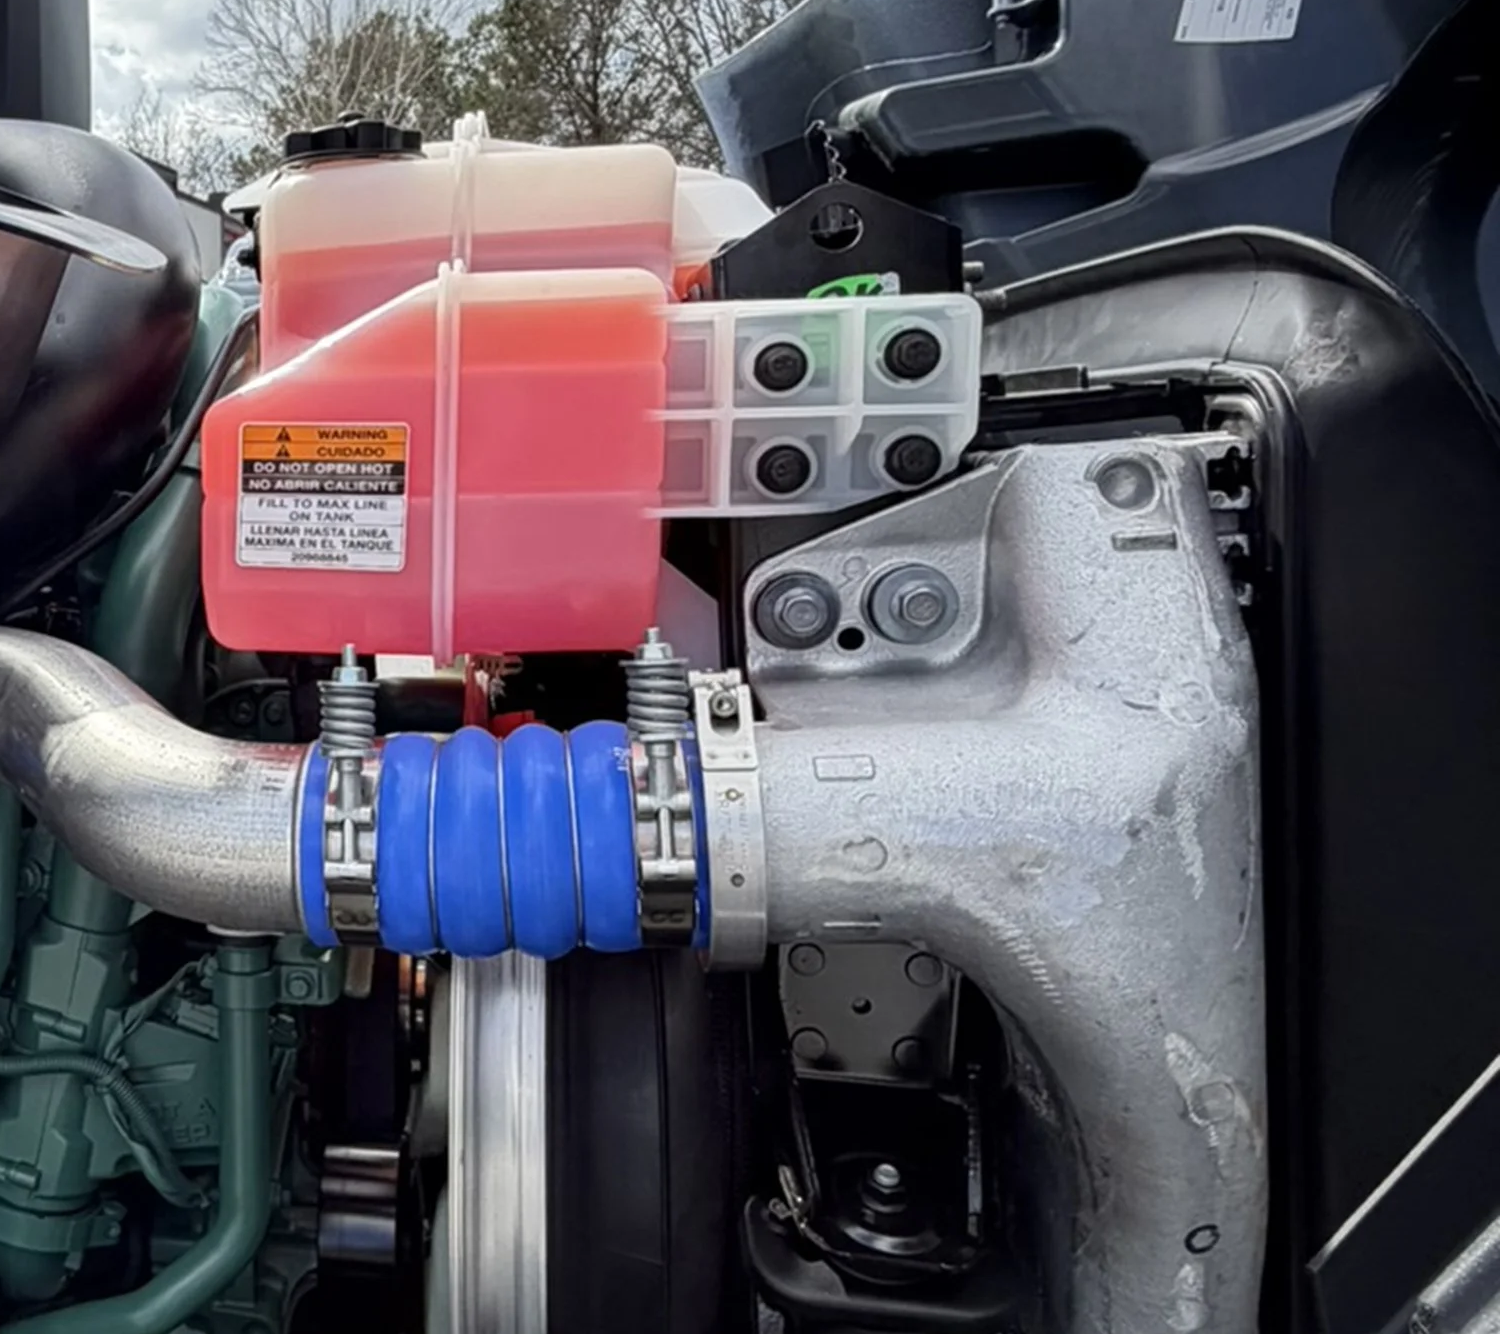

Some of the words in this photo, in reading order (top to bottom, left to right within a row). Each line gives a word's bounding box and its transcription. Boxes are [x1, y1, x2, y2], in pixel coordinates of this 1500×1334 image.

[317, 429, 388, 440] WARNING
[316, 446, 386, 457] CUIDADO
[253, 461, 275, 473] DO
[279, 462, 310, 473] NOT
[314, 462, 356, 474] OPEN
[360, 463, 394, 474] HOT
[248, 479, 271, 490] NO
[273, 479, 320, 491] ABRIR
[324, 480, 398, 492] CALIENTE
[258, 498, 287, 508] FILL
[293, 499, 312, 509] TO
[317, 499, 350, 510] MAX
[354, 500, 387, 510] LINE
[289, 511, 310, 521] ON
[315, 511, 355, 522] TANK
[250, 525, 300, 535] LLENAR
[303, 526, 345, 537] HASTA
[349, 527, 389, 538] LINEA
[244, 537, 295, 547] MAXIMA
[299, 538, 317, 548] EN
[321, 538, 336, 549] EL
[342, 539, 393, 551] TANQUE
